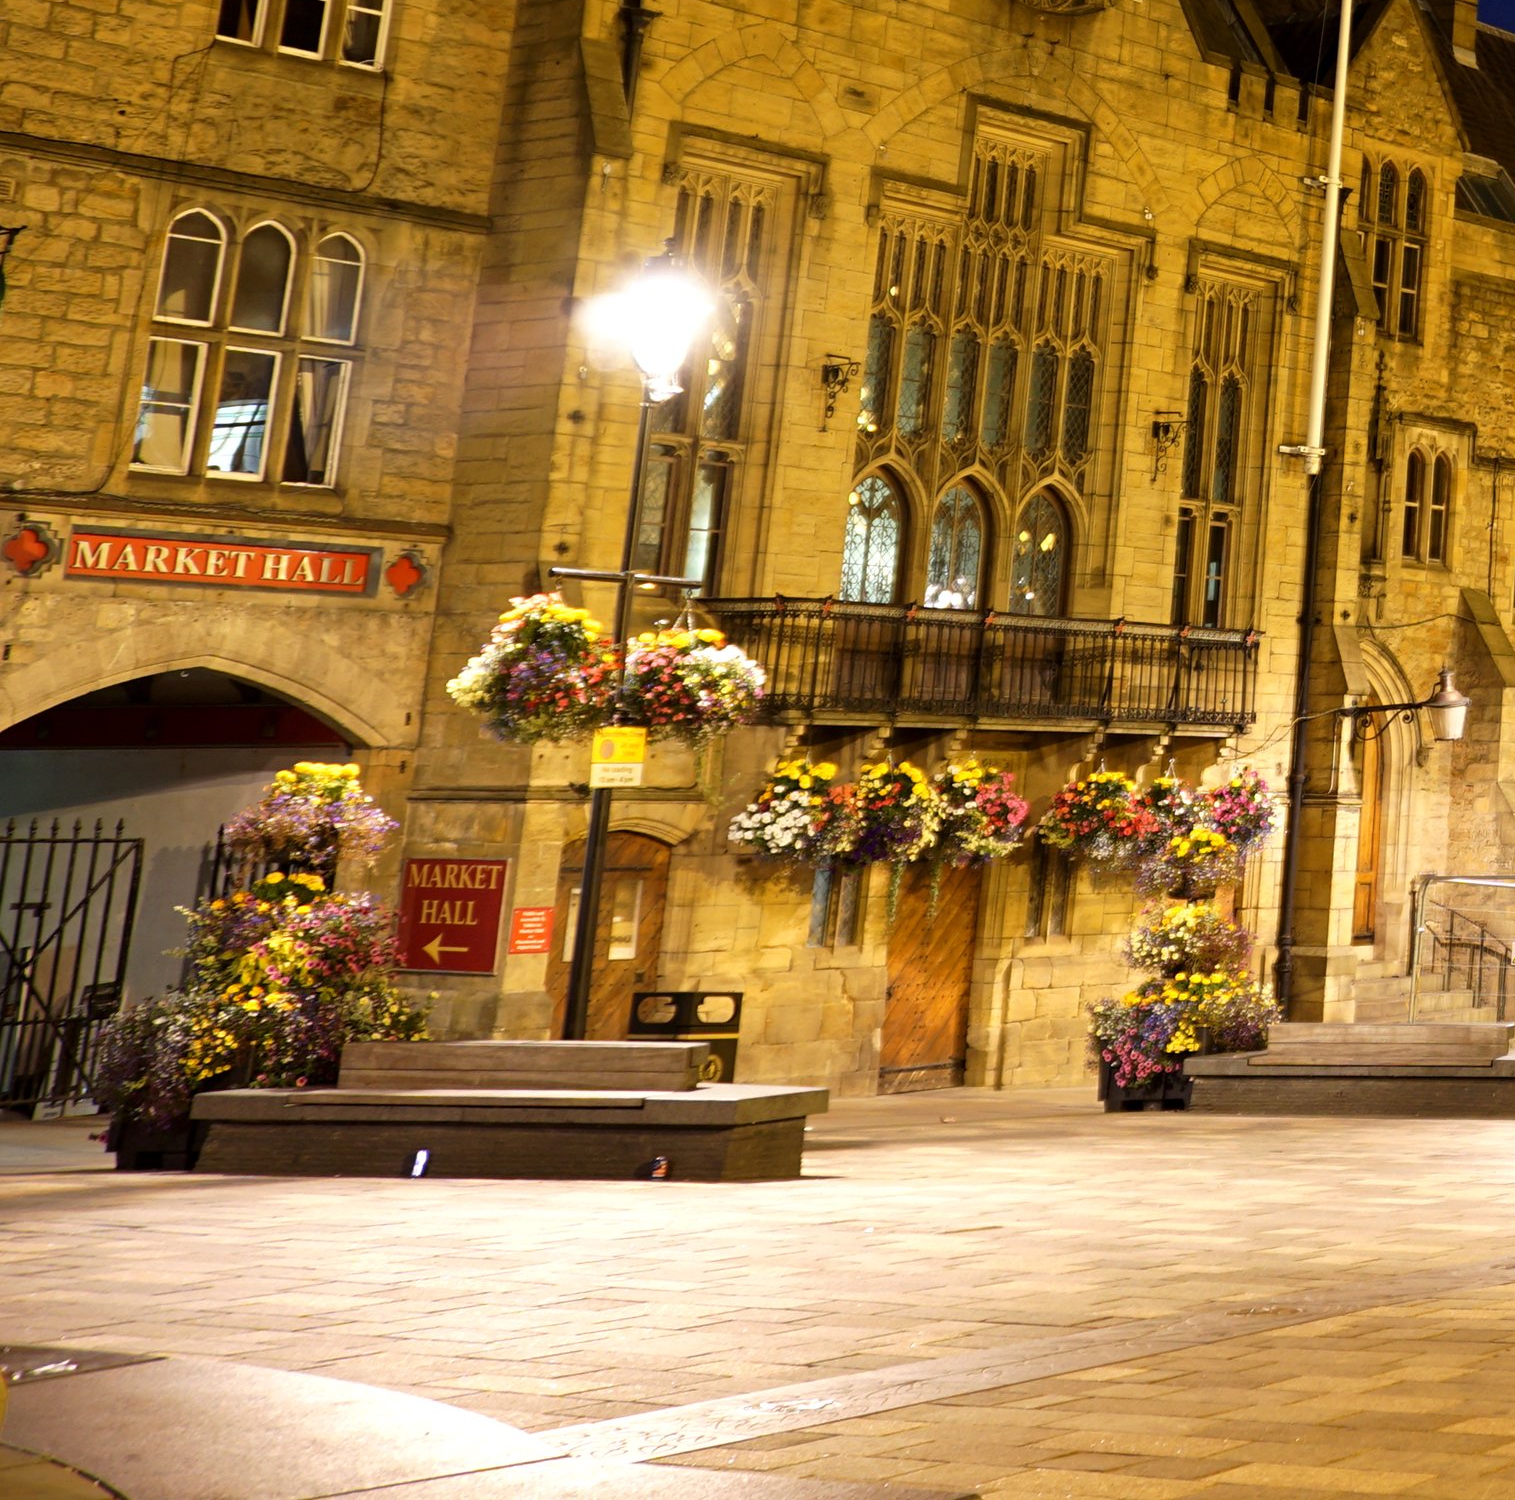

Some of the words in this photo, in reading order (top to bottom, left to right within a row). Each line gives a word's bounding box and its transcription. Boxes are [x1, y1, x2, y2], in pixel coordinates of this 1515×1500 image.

[72, 540, 255, 578] MARKET
[261, 553, 364, 585] HALL
[407, 863, 504, 889] MARKET
[419, 899, 478, 925] HALL
